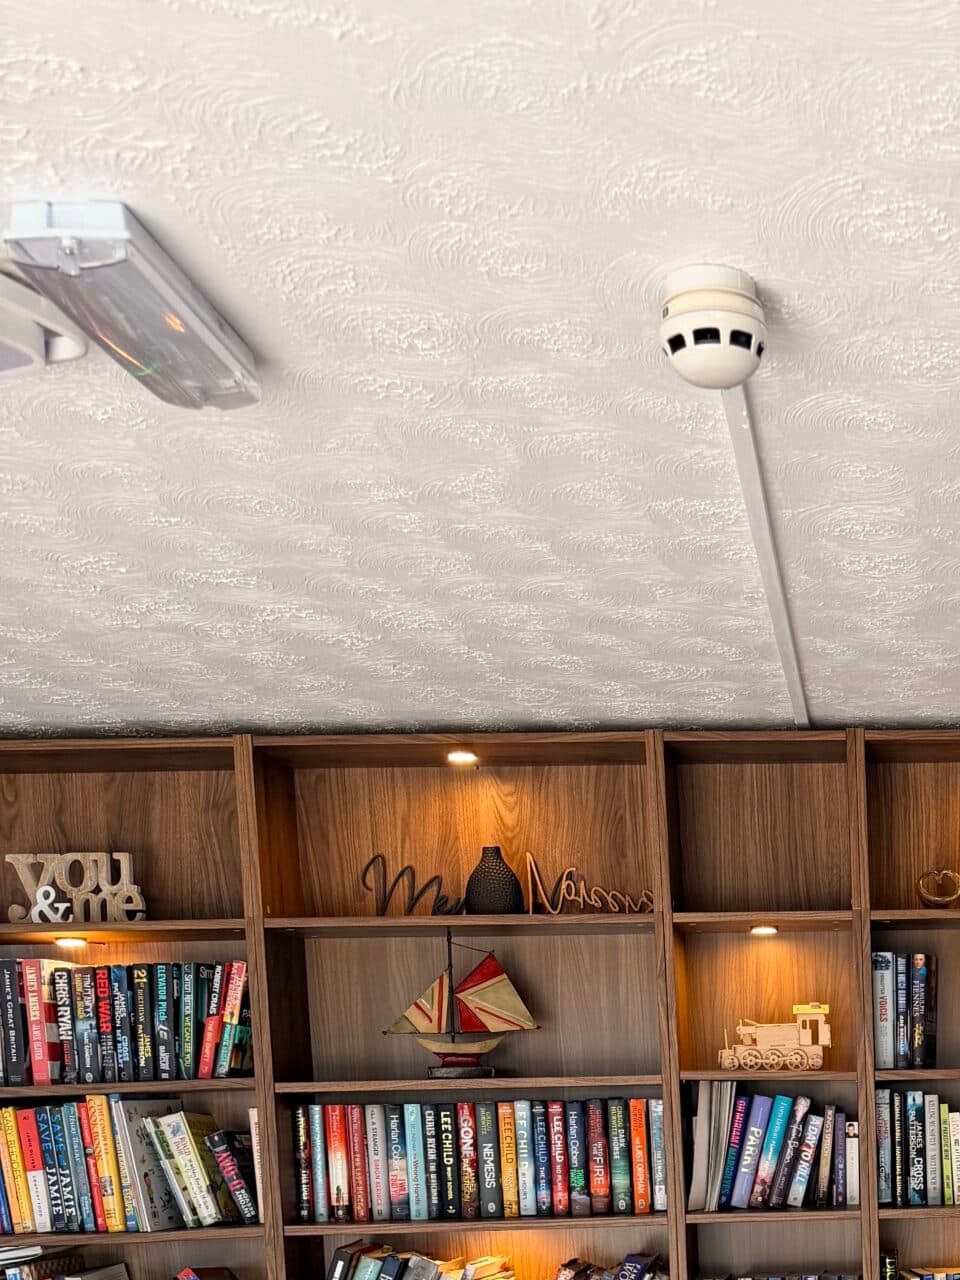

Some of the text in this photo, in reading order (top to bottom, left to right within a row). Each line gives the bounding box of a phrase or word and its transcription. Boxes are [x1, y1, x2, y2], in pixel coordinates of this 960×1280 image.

[5, 852, 133, 922] you
[31, 886, 147, 924] & me
[96, 970, 111, 1032] RED WAR
[113, 983, 121, 1026] PATTERSON
[157, 965, 167, 1000] ELEVATOR
[209, 965, 222, 1014] ROBERT CRAIS
[4, 969, 12, 999] JAMIE'S
[9, 1030, 17, 1061] BRITAIN
[55, 971, 72, 1040] CHRIS RYAN
[879, 995, 888, 1023] VOICES
[137, 1024, 145, 1066] PATTERSON
[3, 1111, 21, 1180] GARY RHODES
[389, 1115, 401, 1173] Harlan Coben
[427, 1138, 437, 1160] RYAN
[441, 1112, 454, 1165] LEE CHILD
[461, 1118, 474, 1158] GONE
[503, 1117, 514, 1164] LEE CHILD
[516, 1104, 528, 1170] LEE CHILD
[536, 1117, 547, 1163] LEE CHILD
[553, 1116, 564, 1162] LEE CHILD
[568, 1112, 579, 1167] Harlan Coben
[612, 1136, 620, 1160] HORSE
[796, 1117, 819, 1183] A DAY TO KILL
[909, 1110, 917, 1158] PATTERSON
[37, 1113, 62, 1215] SAVE JAMIE
[52, 1115, 76, 1216] SAVE JAMIE
[215, 1151, 245, 1191] D-DAY
[463, 1158, 471, 1202] PATTERSON
[467, 1168, 477, 1193] JAMES
[482, 1143, 496, 1188] NEMESIS
[570, 1168, 578, 1187] TWICE
[593, 1157, 604, 1185] FIRE
[637, 1163, 645, 1194] ORPHAN
[914, 1158, 923, 1190] CROSS
[234, 1191, 252, 1218] ANTONY
